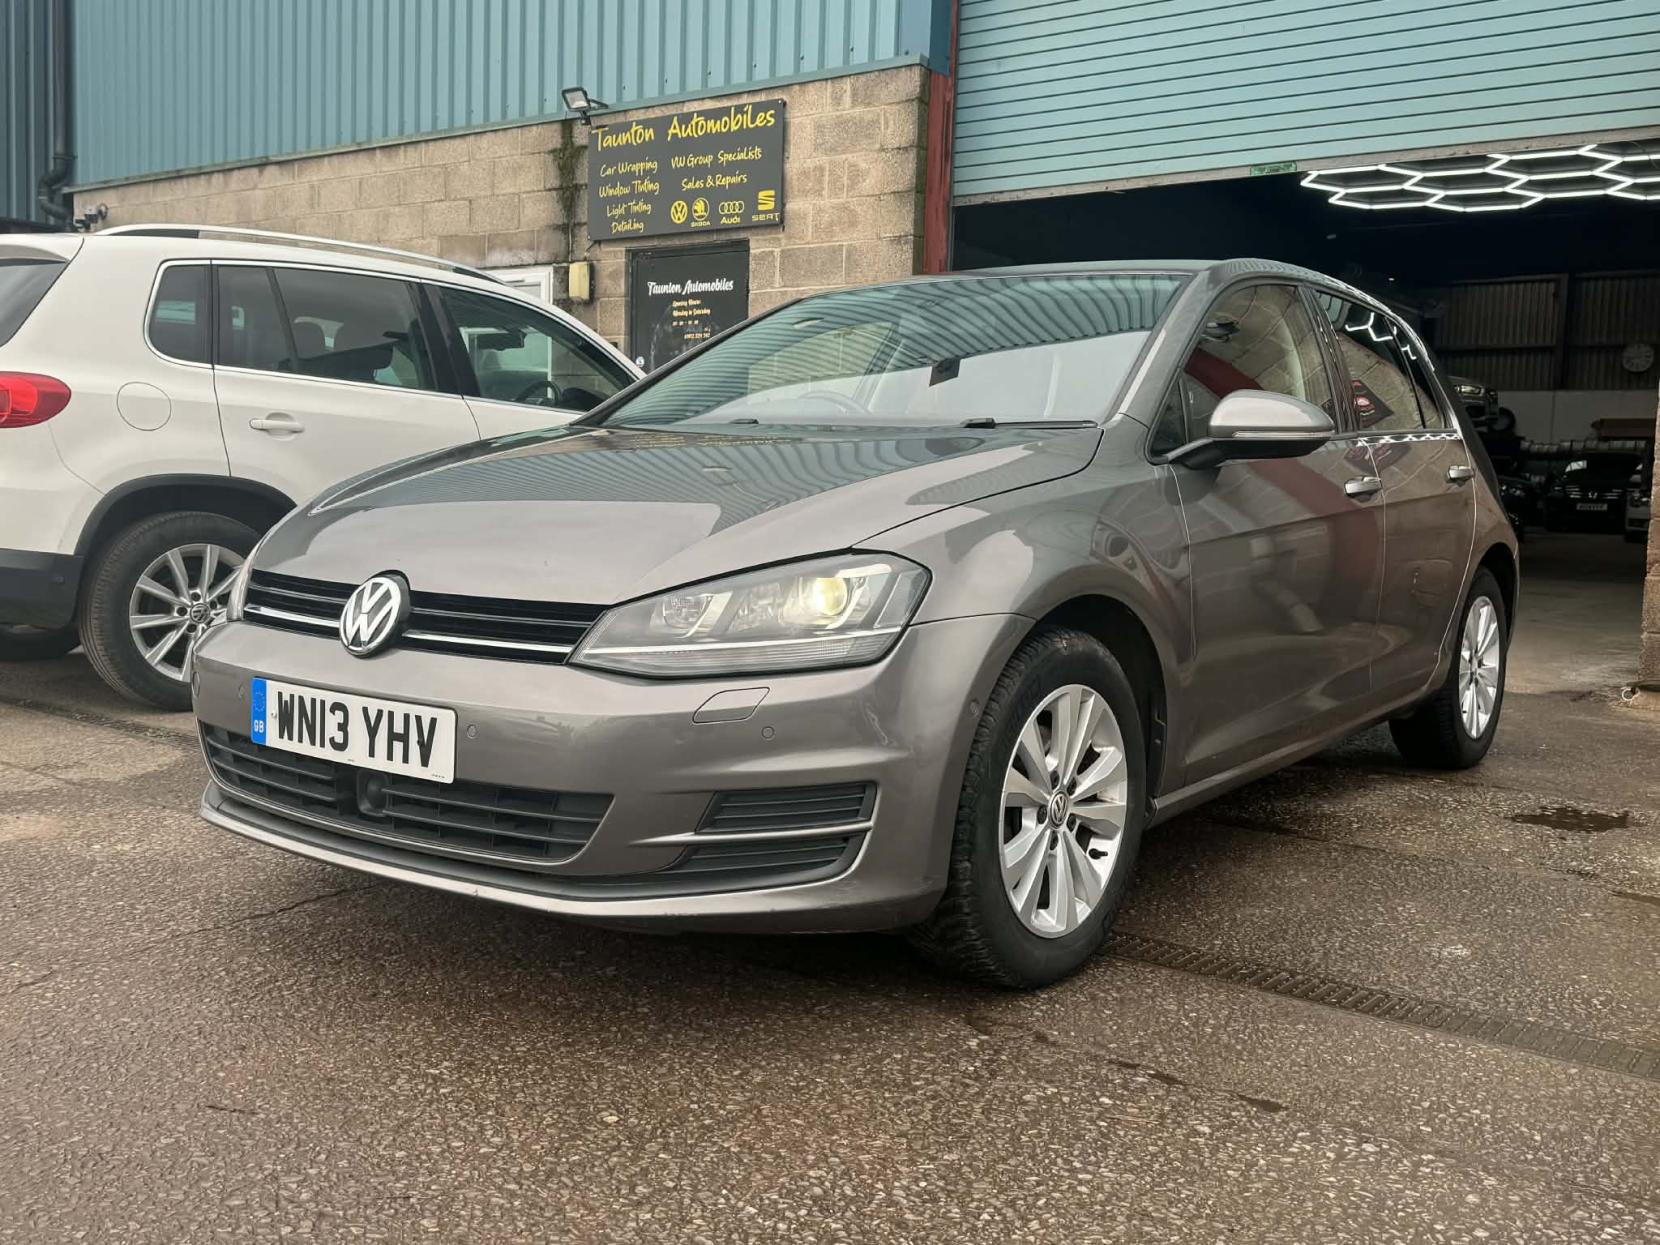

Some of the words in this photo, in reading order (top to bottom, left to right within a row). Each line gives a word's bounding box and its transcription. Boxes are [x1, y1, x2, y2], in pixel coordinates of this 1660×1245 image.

[591, 121, 655, 152] Taunton
[667, 104, 776, 141] Automobiles
[600, 164, 616, 177] Car
[618, 157, 658, 176] Wrapping
[671, 156, 686, 169] VW
[687, 154, 713, 168] Group
[717, 145, 762, 166] Specialists
[599, 181, 631, 198] Window
[632, 177, 660, 195] Tinting
[681, 176, 704, 191] Sales
[705, 175, 715, 188] &
[715, 170, 748, 190] Repairs
[606, 204, 626, 219] Light
[627, 199, 652, 215] Tinting
[751, 212, 780, 222] SEAT
[611, 218, 644, 233] Detailing
[720, 216, 741, 225] Audi
[647, 281, 682, 296] Taunton
[682, 278, 734, 295] Automobiles
[253, 719, 265, 733] GB
[277, 691, 349, 752] WN13
[362, 706, 438, 768] YHV
